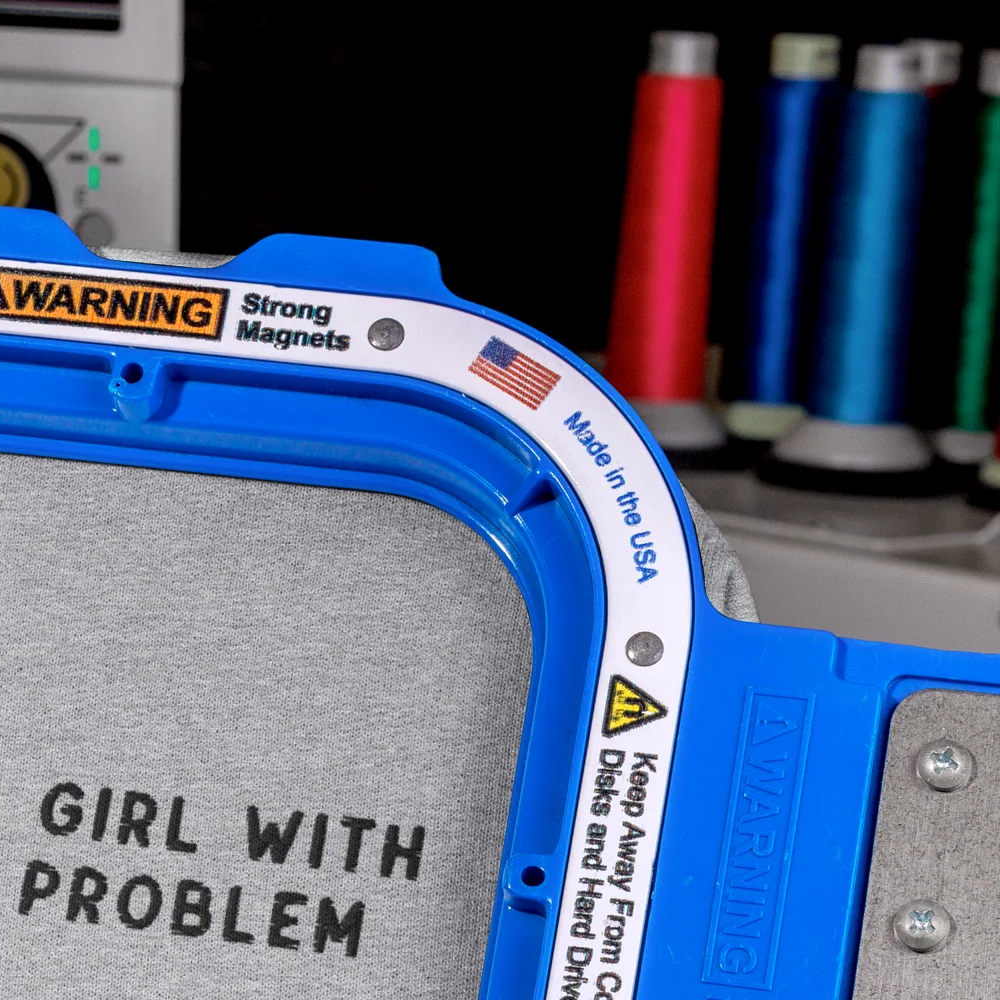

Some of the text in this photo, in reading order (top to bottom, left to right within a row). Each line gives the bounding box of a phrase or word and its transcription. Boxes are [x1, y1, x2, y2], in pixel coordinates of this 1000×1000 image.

[12, 277, 212, 328] WARNING
[235, 319, 351, 352] Magnets
[241, 292, 333, 326] Strong
[563, 410, 658, 585] Made in the USA
[590, 749, 626, 817] Disks
[620, 752, 659, 817] Keep
[40, 781, 198, 854] GIRL
[246, 804, 426, 881] WITH
[581, 823, 607, 871] and
[607, 821, 646, 892] Away
[719, 751, 789, 976] WARNING
[18, 859, 366, 958] PROBLEM
[570, 876, 604, 940] Hard
[600, 897, 634, 964] From
